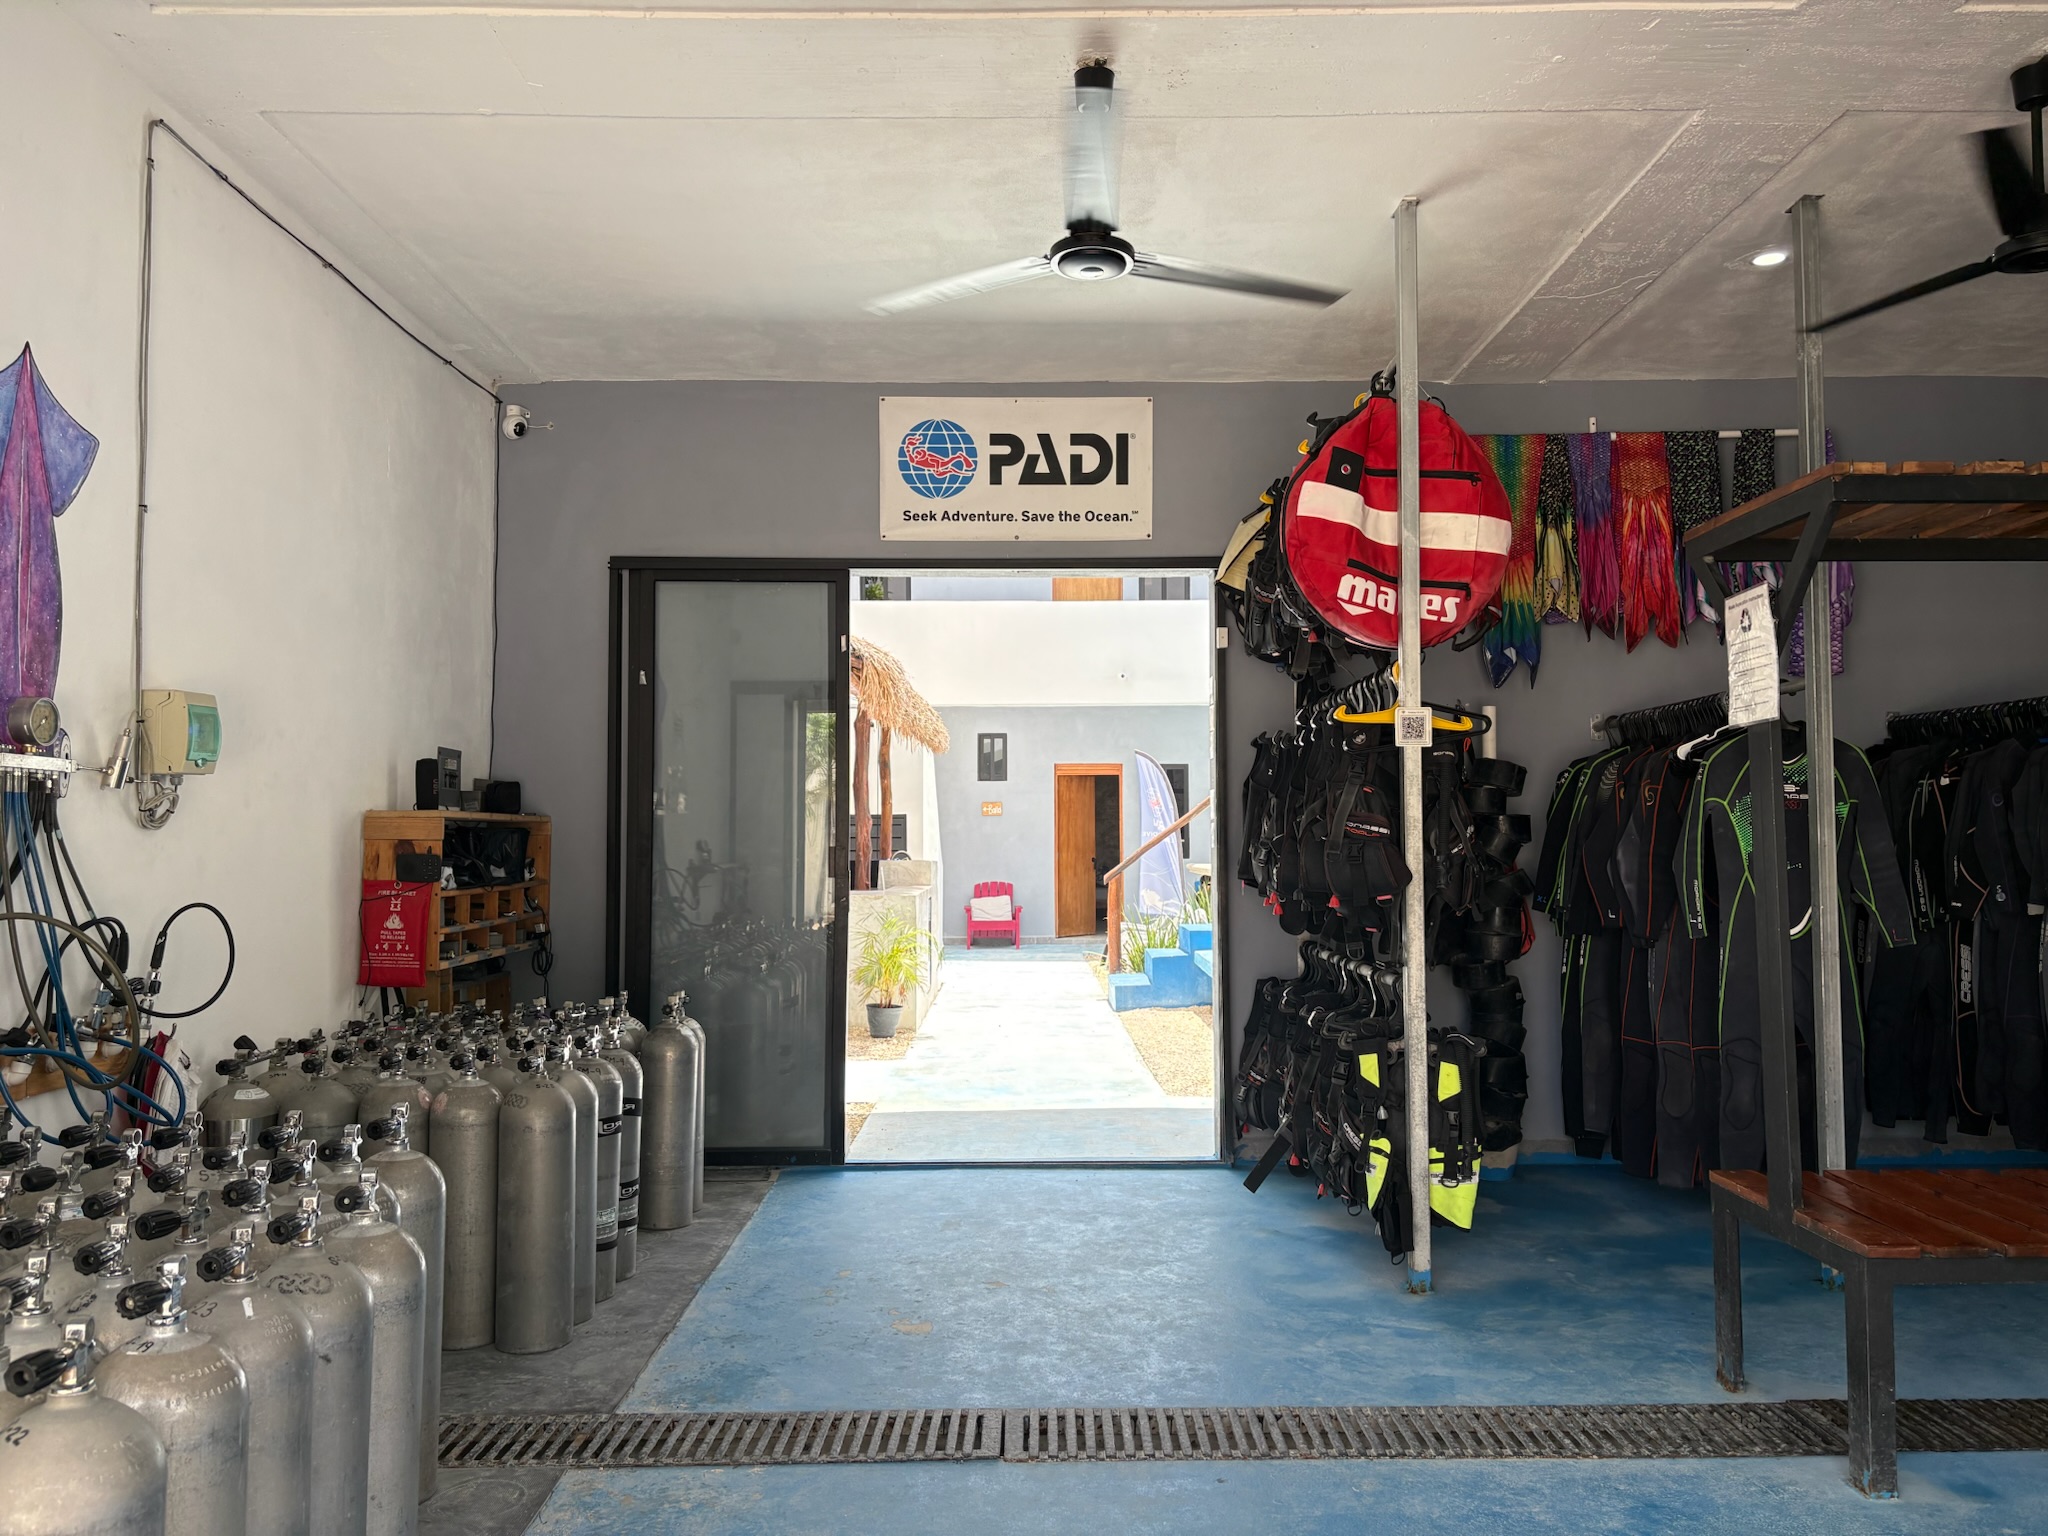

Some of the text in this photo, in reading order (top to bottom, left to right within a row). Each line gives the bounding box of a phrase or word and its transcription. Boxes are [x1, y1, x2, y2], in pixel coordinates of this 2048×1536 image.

[989, 433, 1129, 485] PADI
[902, 510, 938, 522] Seek
[940, 510, 1018, 522] Adventure.
[1021, 510, 1055, 522] Save
[1058, 510, 1081, 522] the
[1084, 510, 1133, 522] Ocean.
[1336, 573, 1461, 623] maes
[1959, 943, 1972, 1004] CRESSI
